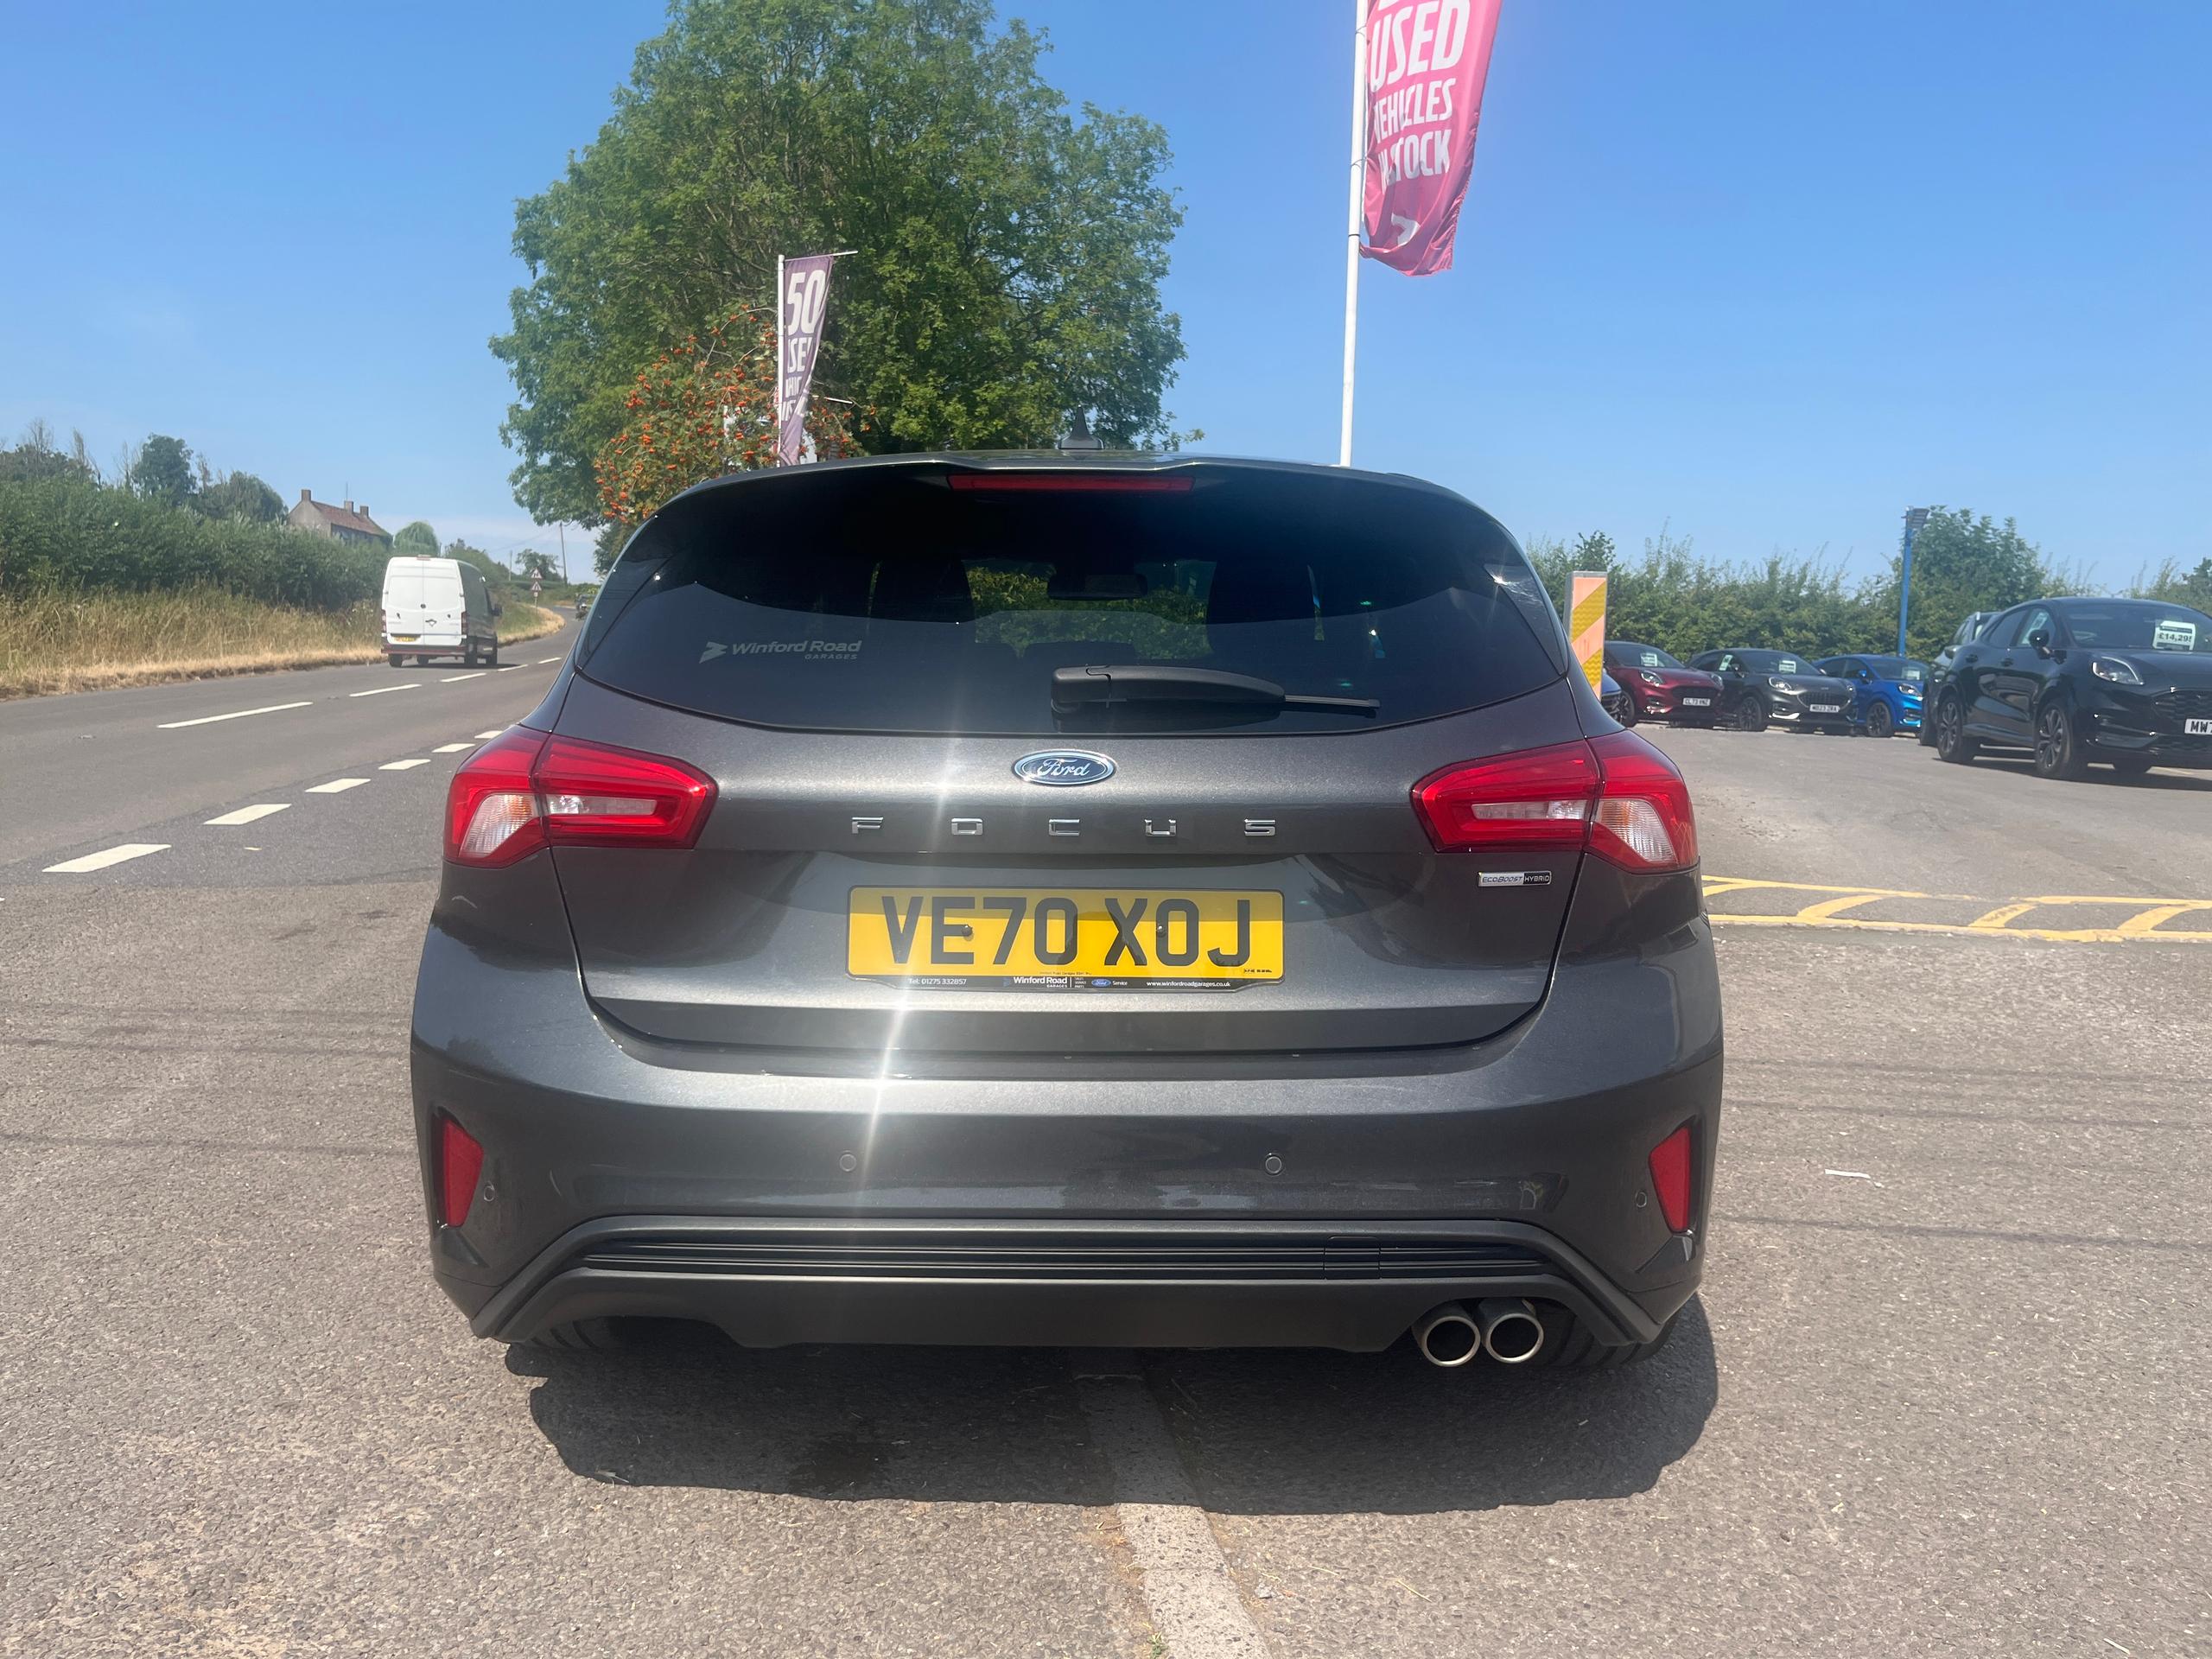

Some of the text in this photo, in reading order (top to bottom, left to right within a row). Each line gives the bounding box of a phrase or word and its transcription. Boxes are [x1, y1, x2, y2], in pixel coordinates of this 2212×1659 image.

[1370, 0, 1470, 92] USED
[787, 270, 826, 335] 50
[788, 336, 812, 373] SE
[733, 640, 862, 655] Winford Road
[2190, 721, 2212, 733] MW
[1038, 758, 1090, 776] Ford
[852, 817, 1277, 837] FOCUS
[881, 896, 1250, 967] VE70 XOJ
